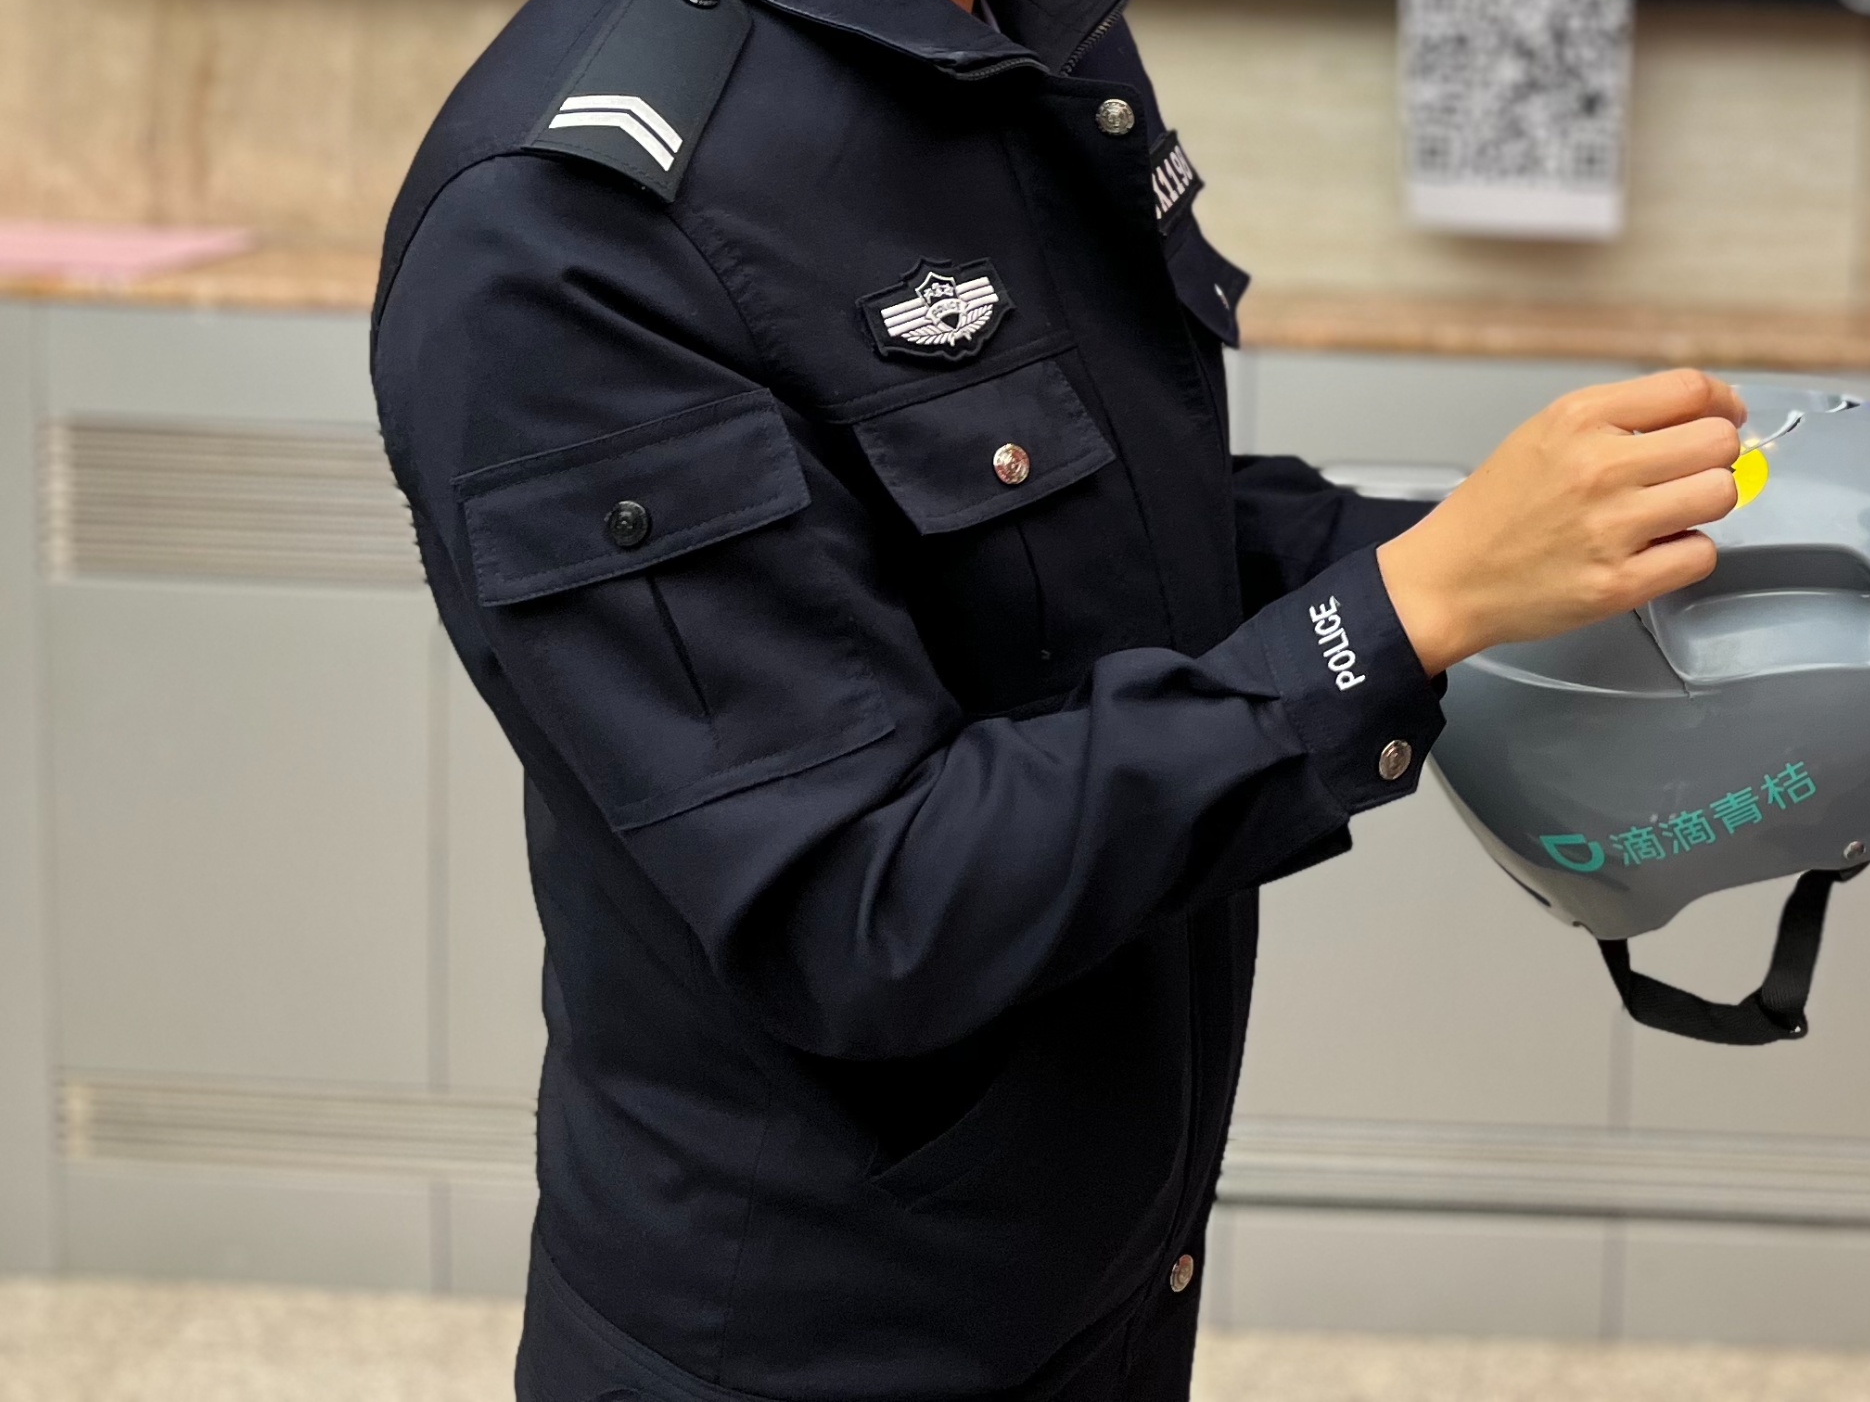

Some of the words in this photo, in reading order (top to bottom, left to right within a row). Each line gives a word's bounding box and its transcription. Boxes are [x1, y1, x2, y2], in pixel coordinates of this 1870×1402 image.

[1308, 595, 1366, 691] POLICE
[1608, 761, 1817, 868] 滴滴青桔
